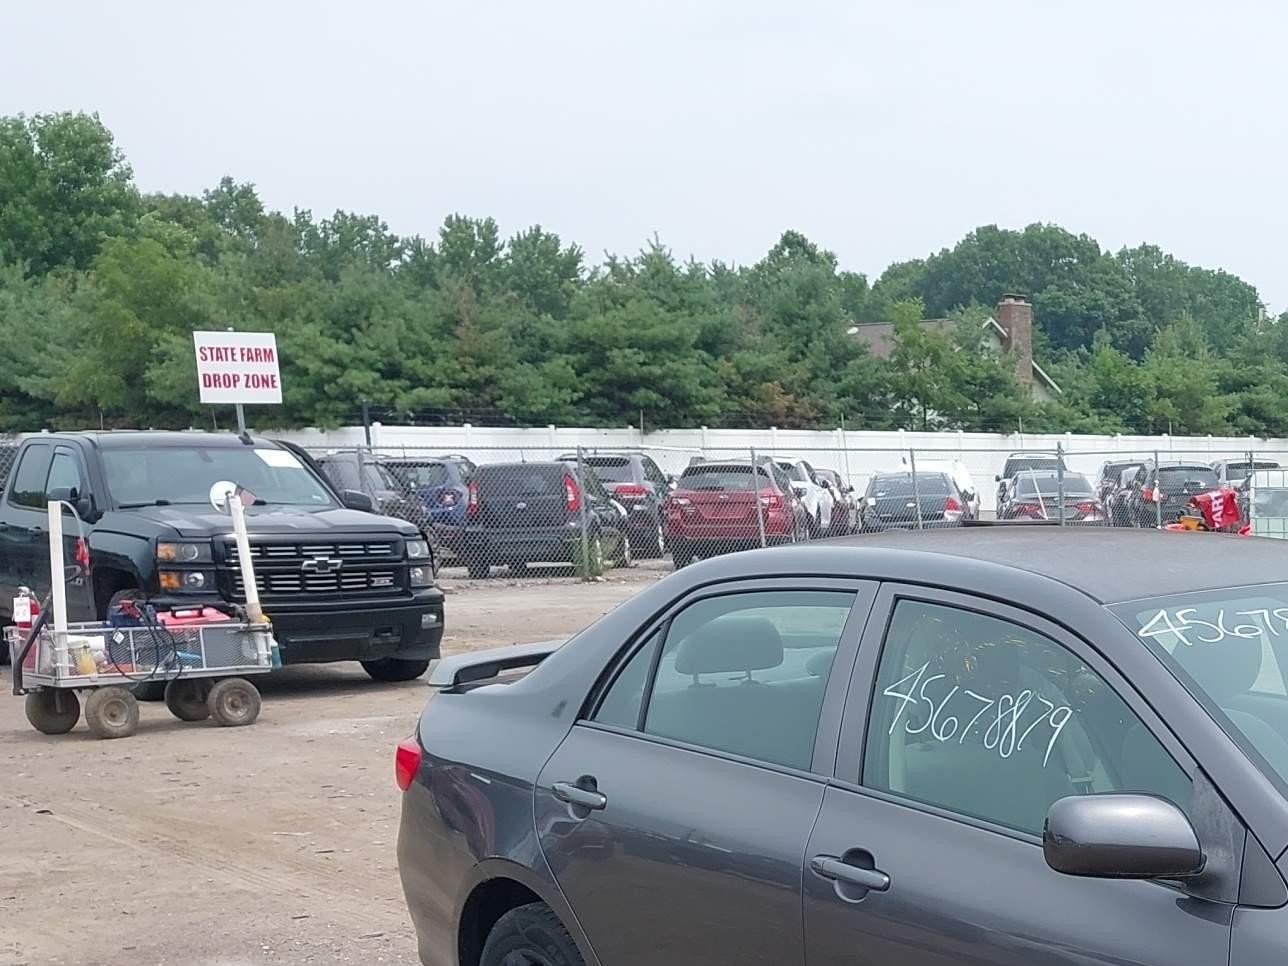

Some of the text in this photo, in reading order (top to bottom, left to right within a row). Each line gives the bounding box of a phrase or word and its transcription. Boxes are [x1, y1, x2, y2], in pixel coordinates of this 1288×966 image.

[199, 346, 274, 362] STATE FARM
[202, 373, 278, 389] DROP ZONE
[883, 660, 1074, 768] 45678879
